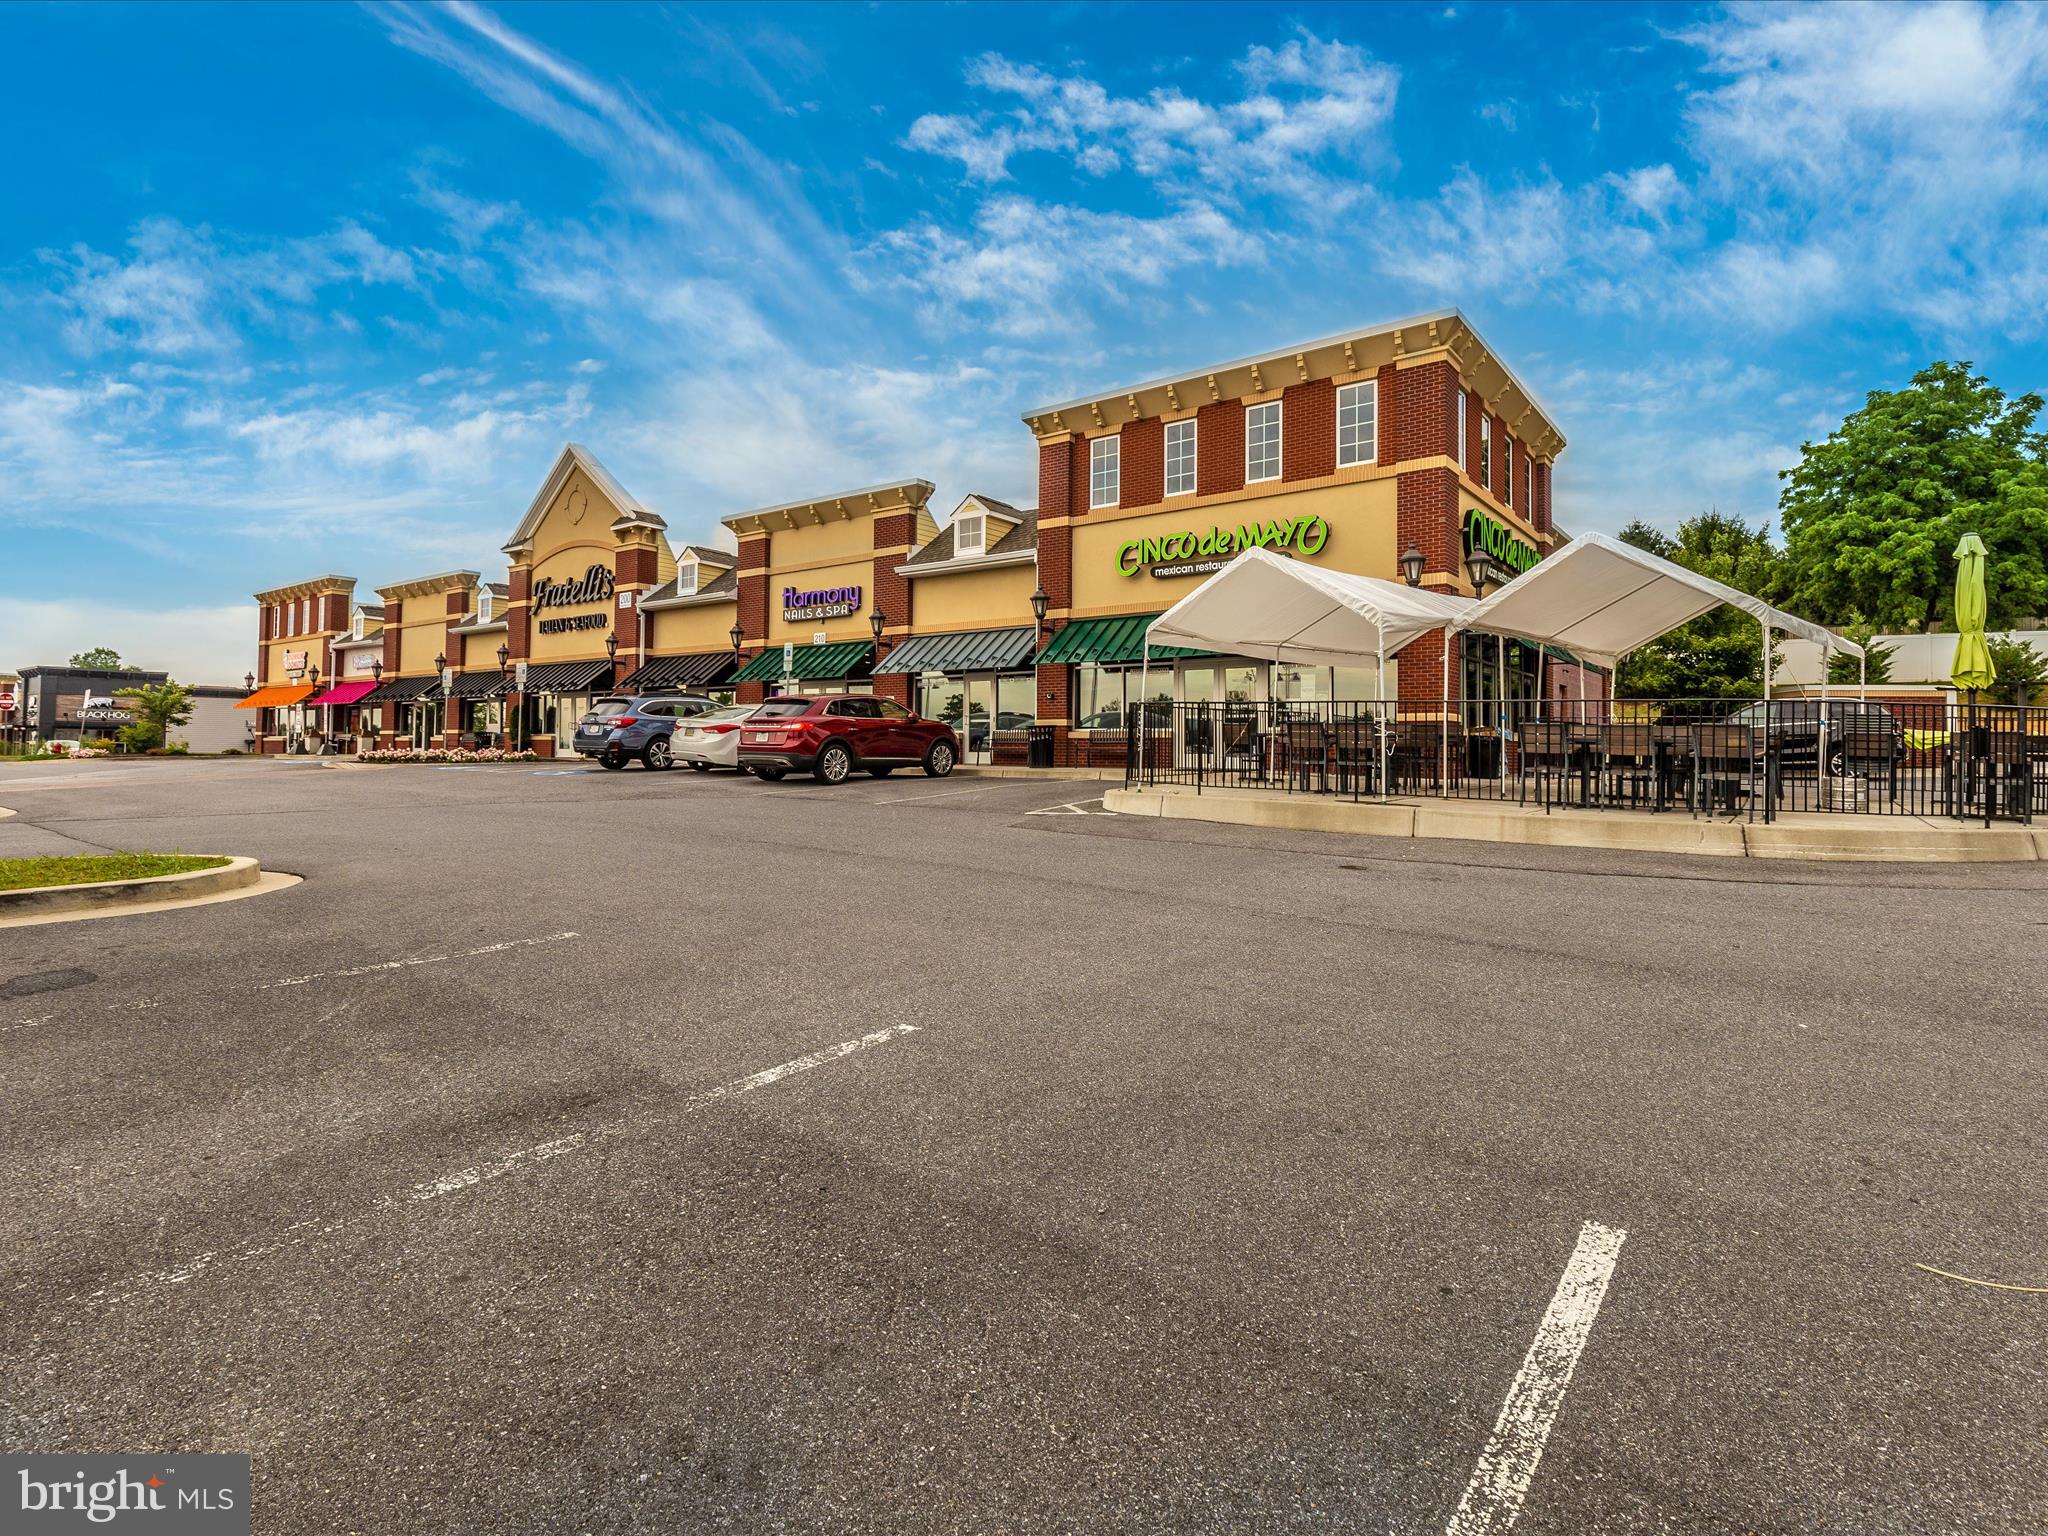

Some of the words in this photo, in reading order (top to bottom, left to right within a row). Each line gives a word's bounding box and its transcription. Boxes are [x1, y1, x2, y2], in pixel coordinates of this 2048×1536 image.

[1115, 532, 1197, 576] CINCO
[1200, 527, 1231, 555] de
[1234, 515, 1329, 555] MAYO
[1471, 508, 1505, 561] CINCO
[1505, 529, 1517, 568] de
[1155, 564, 1194, 576] mexican
[1194, 560, 1232, 572] restaur
[529, 564, 615, 615] Fratelli's
[620, 593, 631, 604] 200
[783, 586, 861, 610] Harmony
[784, 609, 812, 620] NAILS
[816, 607, 824, 617] &
[826, 604, 848, 616] SPA
[814, 634, 825, 643] 210
[107, 711, 130, 719] HOG
